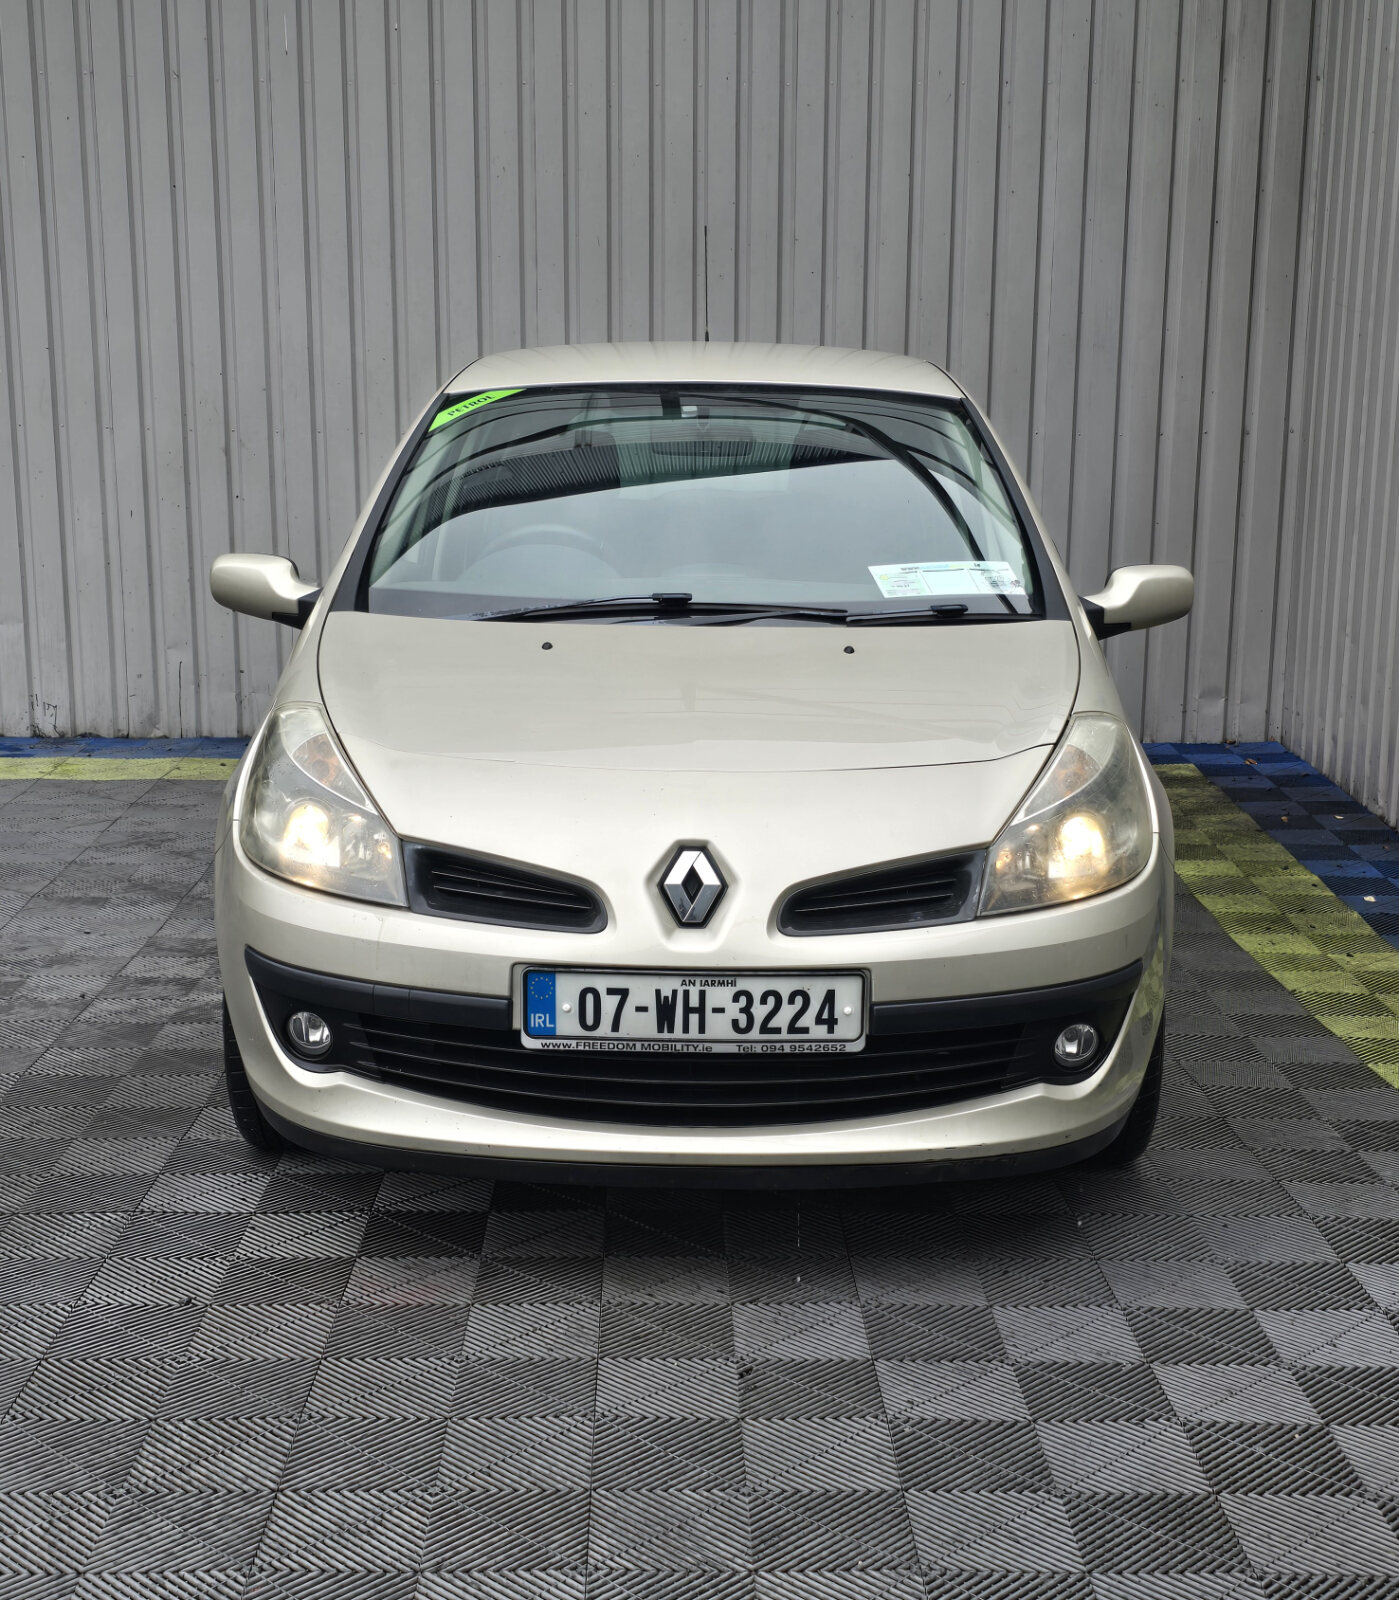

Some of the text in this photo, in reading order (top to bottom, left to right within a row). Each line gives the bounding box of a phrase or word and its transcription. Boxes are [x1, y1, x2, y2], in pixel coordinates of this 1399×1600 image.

[447, 395, 495, 416] PETROL
[680, 979, 696, 987] AN
[578, 986, 839, 1035] 07-WH-3224
[530, 1013, 555, 1028] IRL
[641, 1042, 713, 1053] MOBILITY.ie
[736, 1044, 757, 1053] Tel:
[760, 1044, 785, 1053] 094
[789, 1044, 847, 1053] 9542652
